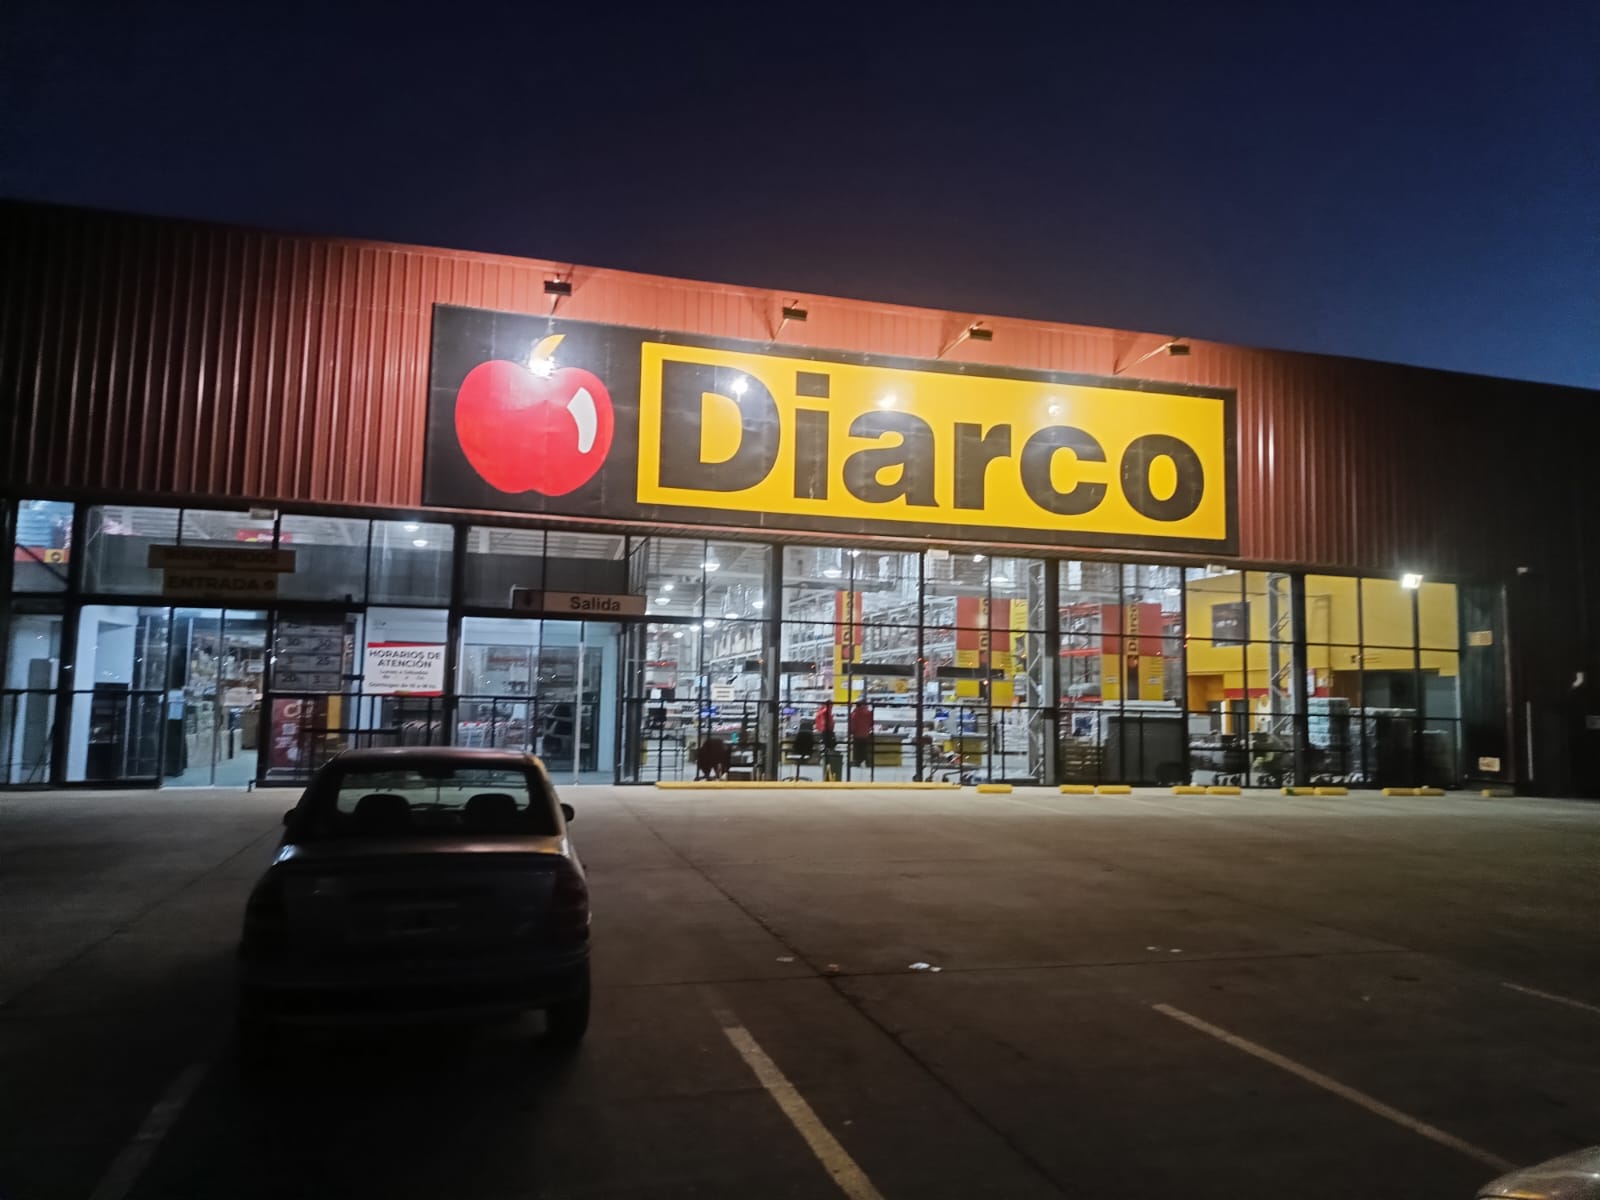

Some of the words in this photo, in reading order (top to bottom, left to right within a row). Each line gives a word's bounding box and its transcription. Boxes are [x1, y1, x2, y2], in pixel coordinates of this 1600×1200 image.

[659, 359, 1204, 522] Diarco
[166, 575, 257, 590] ENTRADA
[570, 596, 621, 612] Salida
[369, 649, 425, 660] HORARIOS
[427, 651, 441, 660] DE
